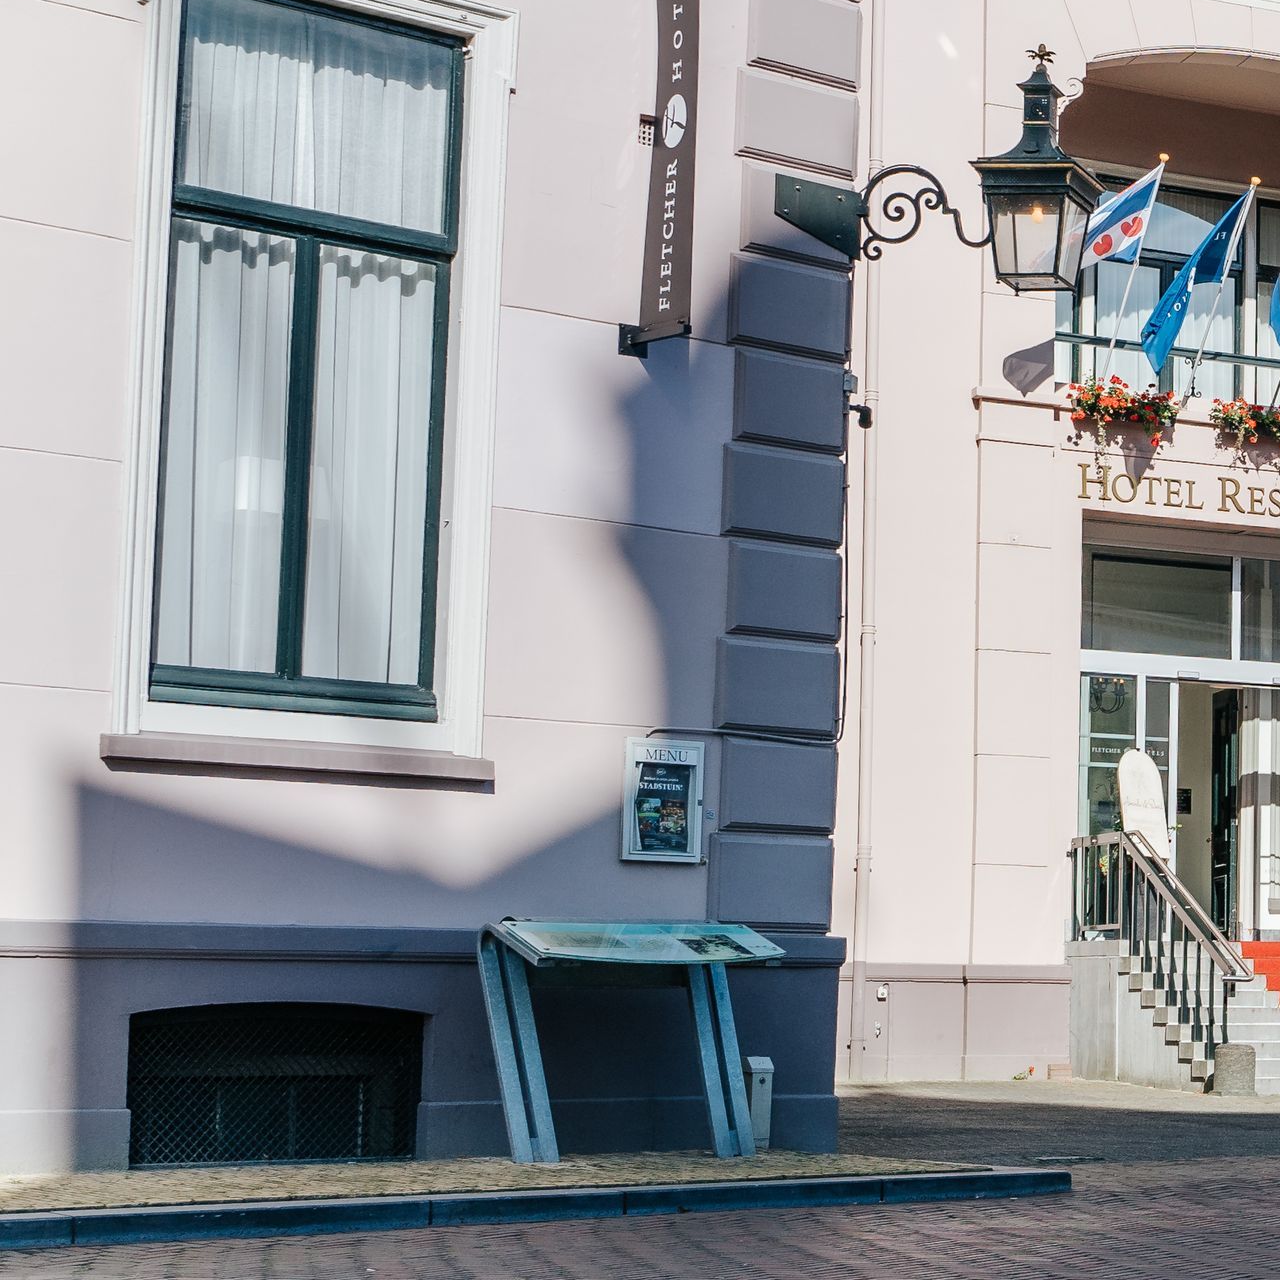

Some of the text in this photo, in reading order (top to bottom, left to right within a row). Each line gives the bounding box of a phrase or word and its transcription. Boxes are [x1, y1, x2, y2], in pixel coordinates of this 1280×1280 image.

[658, 158, 679, 312] FLETCHER
[1077, 463, 1205, 511] HOTEL
[645, 748, 689, 763] MENU
